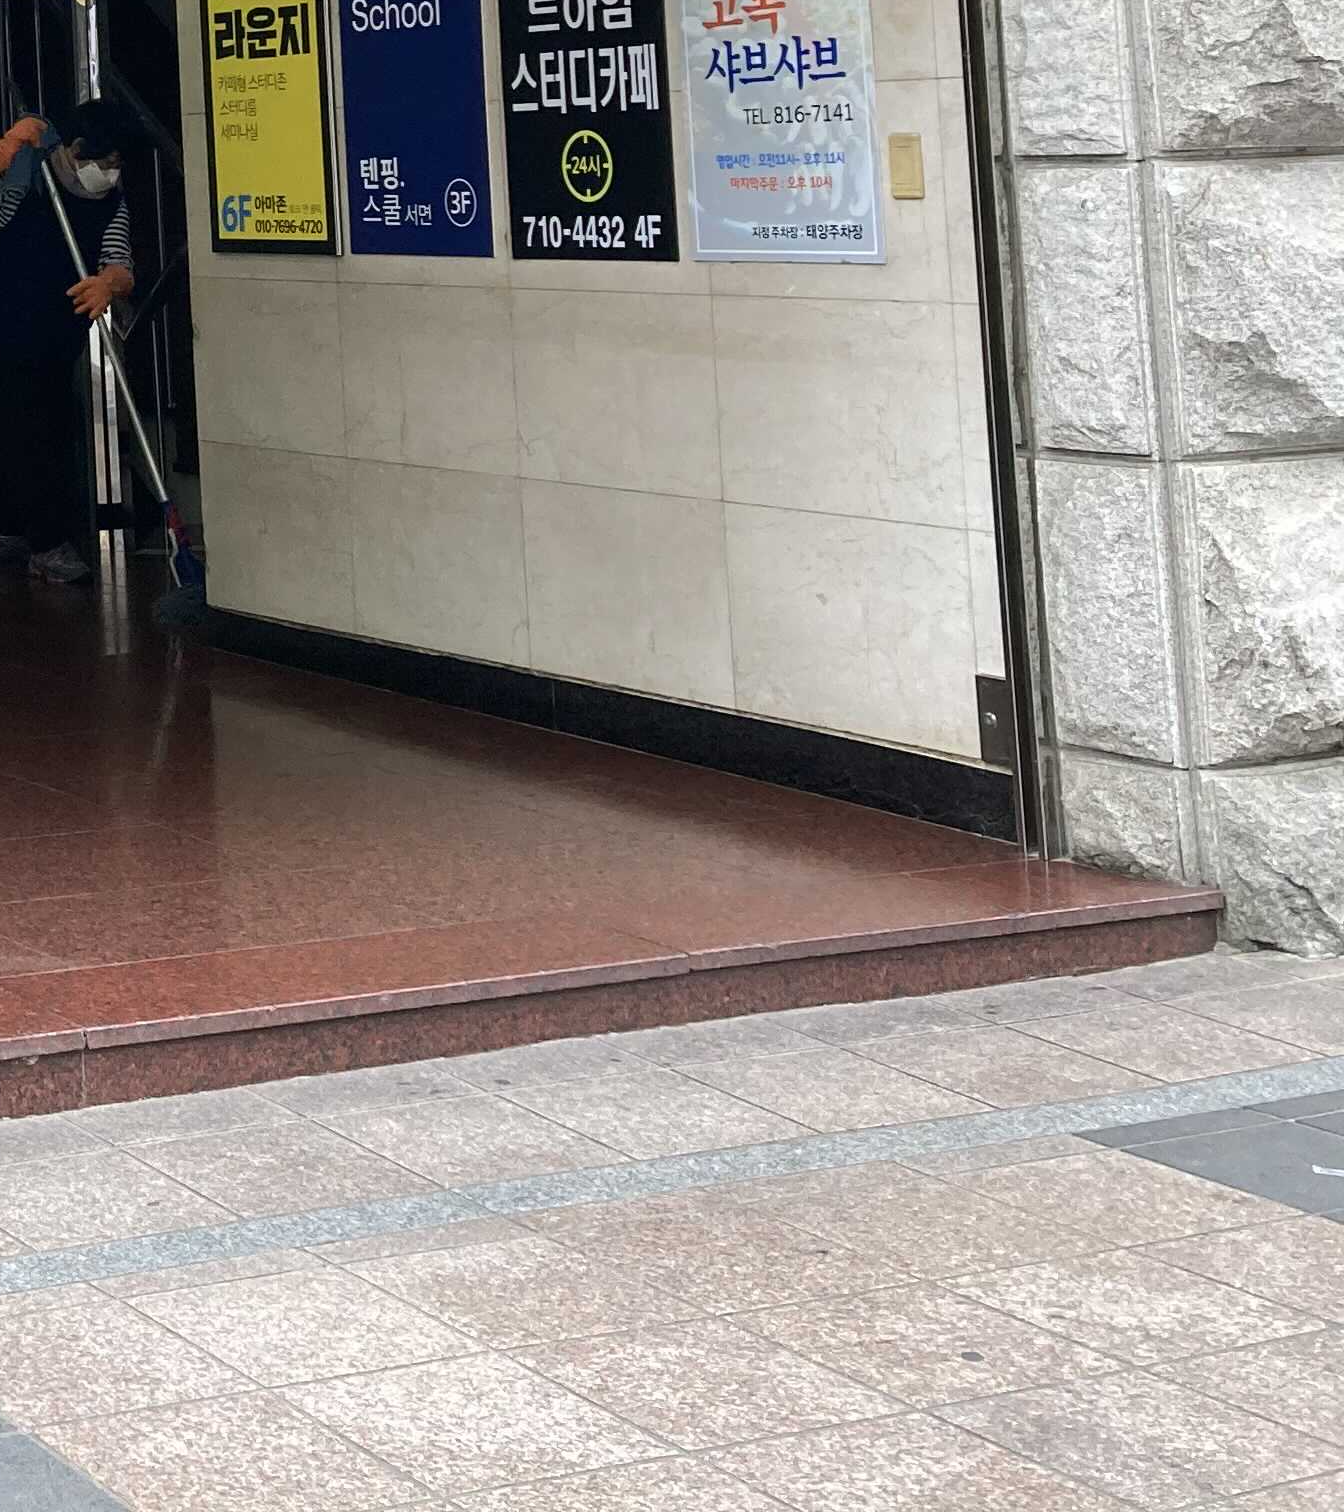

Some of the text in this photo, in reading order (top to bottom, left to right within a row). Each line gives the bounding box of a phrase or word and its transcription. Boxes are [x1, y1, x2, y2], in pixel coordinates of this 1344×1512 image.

[214, 3, 310, 61] 라운지
[511, 42, 660, 114] 스터디카페
[705, 35, 847, 93] 샤브샤브
[774, 103, 854, 124] 816-7141
[360, 157, 405, 191] 텐핑.
[570, 154, 601, 177] 24시
[222, 194, 252, 232] 6F
[255, 194, 288, 214] 아마존
[363, 194, 432, 227] 스쿨 서면
[449, 191, 472, 215] 3F
[523, 215, 662, 249] 710-4432 4F
[806, 224, 864, 240] 태양주차장
